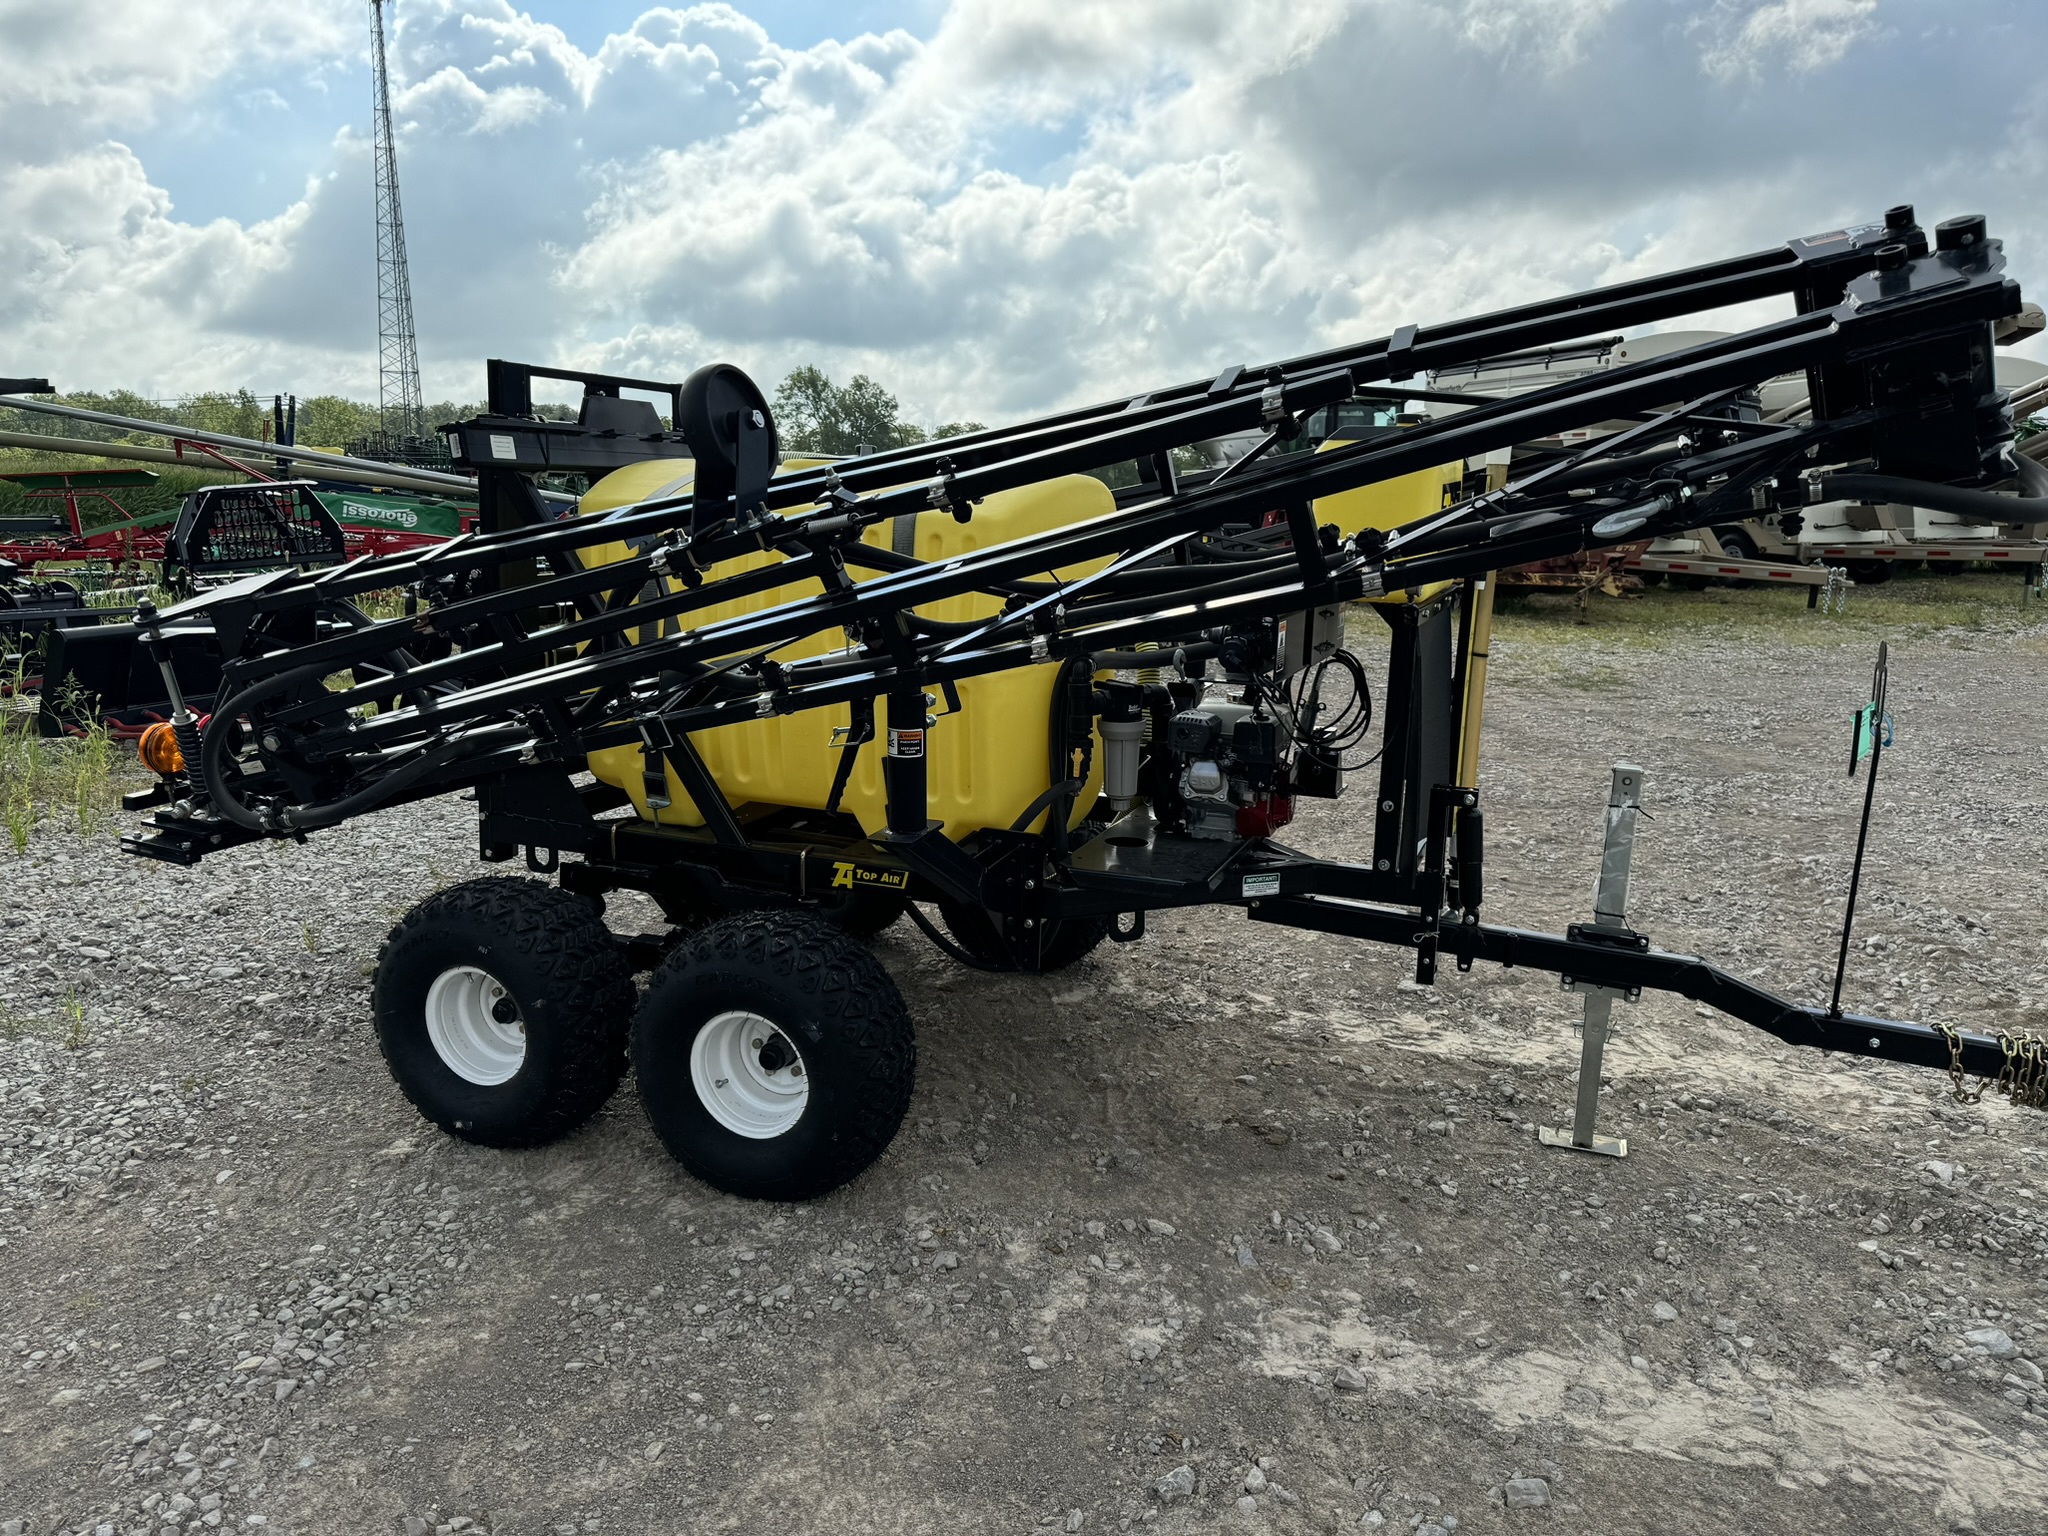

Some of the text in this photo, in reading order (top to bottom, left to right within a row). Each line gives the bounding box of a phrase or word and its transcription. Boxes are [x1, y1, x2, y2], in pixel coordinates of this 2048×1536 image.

[342, 503, 418, 527] enorossi
[856, 869, 878, 881] TOP
[880, 872, 901, 884] AIR
